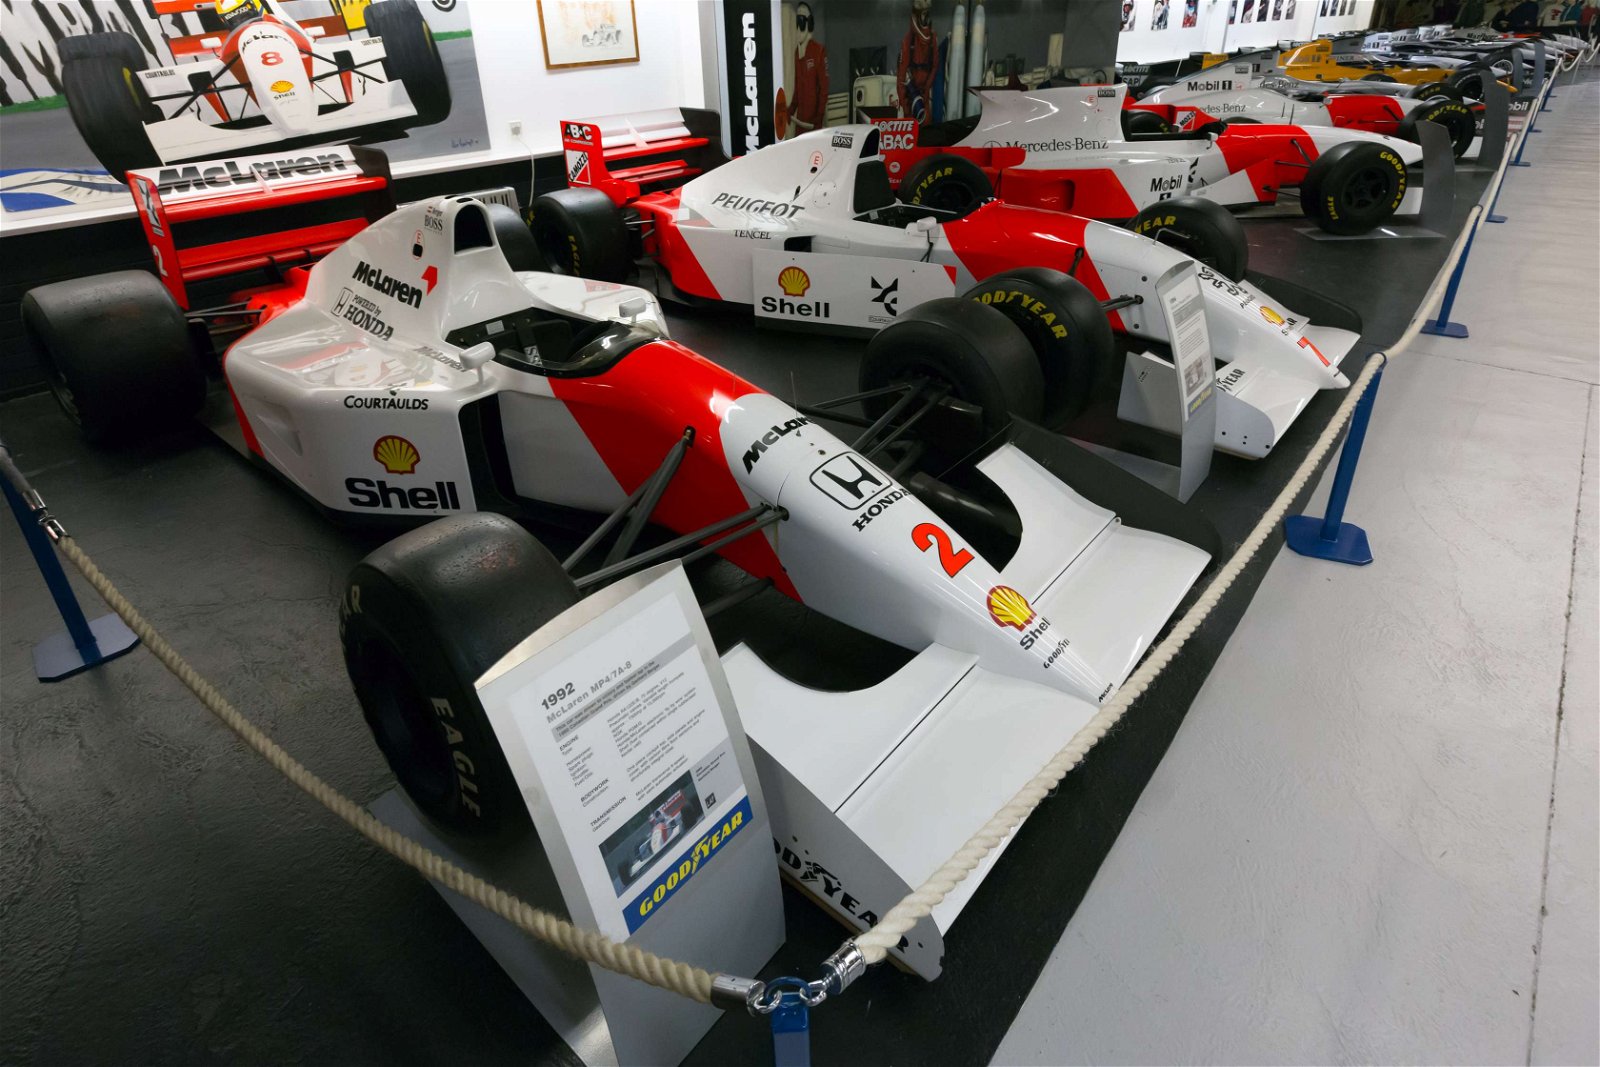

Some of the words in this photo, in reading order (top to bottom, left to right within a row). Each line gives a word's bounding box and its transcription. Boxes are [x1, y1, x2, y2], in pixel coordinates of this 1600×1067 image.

[260, 51, 283, 66] 8
[1187, 81, 1219, 92] Mobil
[1222, 80, 1232, 91] 1
[1005, 137, 1110, 153] Mercedes-Benz
[157, 150, 348, 195] McLaren
[1150, 174, 1183, 192] Mobil
[712, 192, 805, 220] PEUGEOT
[424, 214, 443, 232] BOSS
[733, 229, 772, 240] TENCEL
[152, 244, 169, 277] 2
[352, 260, 423, 310] McLaren
[343, 304, 395, 342] HONDA
[761, 296, 830, 319] Shell
[1297, 336, 1332, 368] 7
[343, 395, 430, 411] COURTAULDS
[344, 477, 461, 511] Shell
[911, 522, 975, 578] 2
[540, 680, 575, 711] 1992
[546, 689, 589, 724] McLaren
[431, 697, 481, 818] EAGLE
[639, 810, 744, 917] GOODYEAR
